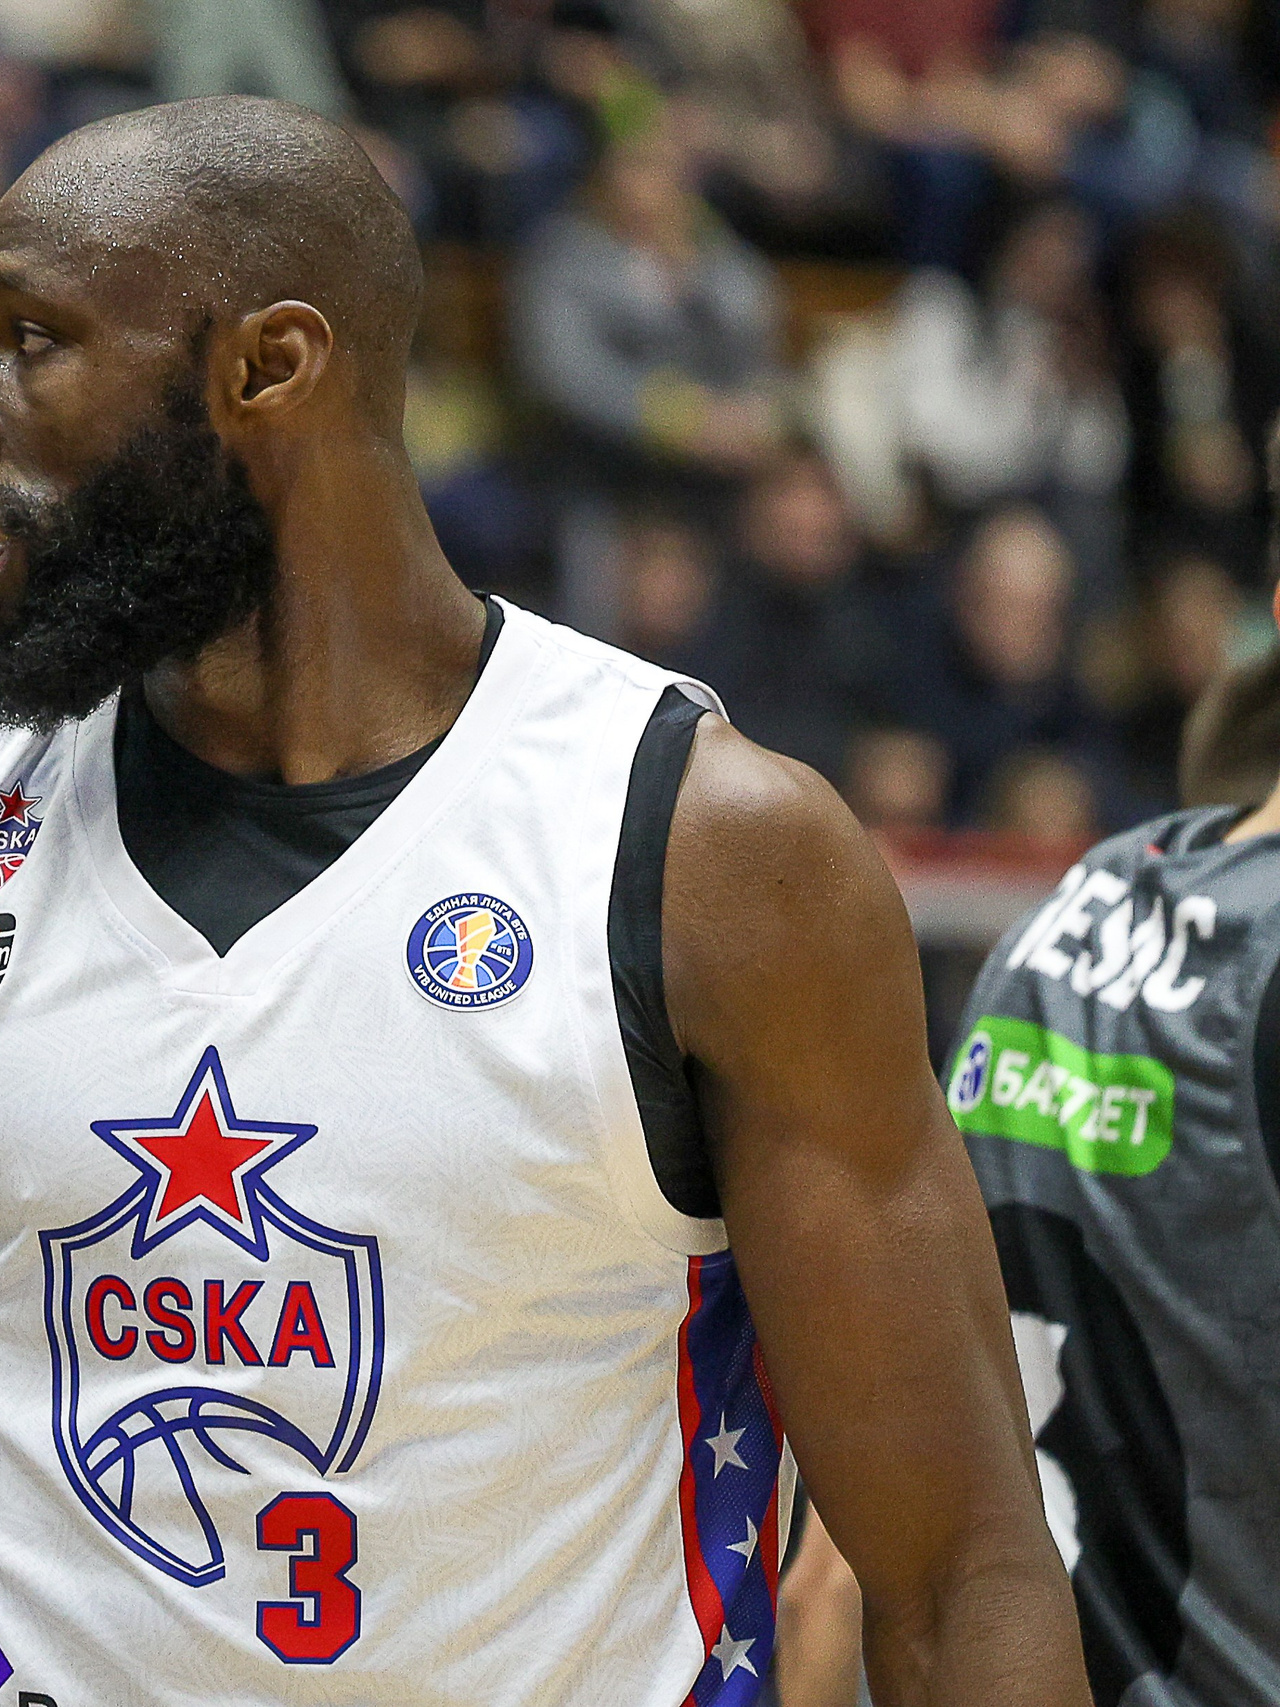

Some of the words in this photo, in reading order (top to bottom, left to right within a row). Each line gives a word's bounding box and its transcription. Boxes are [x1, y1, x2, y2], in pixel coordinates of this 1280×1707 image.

[426, 895, 478, 922] ЕДИНАЯ
[480, 896, 513, 920] ЛИГА
[511, 918, 528, 941] ВТБ
[413, 964, 430, 987] VTB
[428, 983, 471, 1005] UNITED
[474, 979, 517, 1005] LEAGUE
[85, 1274, 337, 1369] CSKA
[256, 1491, 361, 1665] 3
